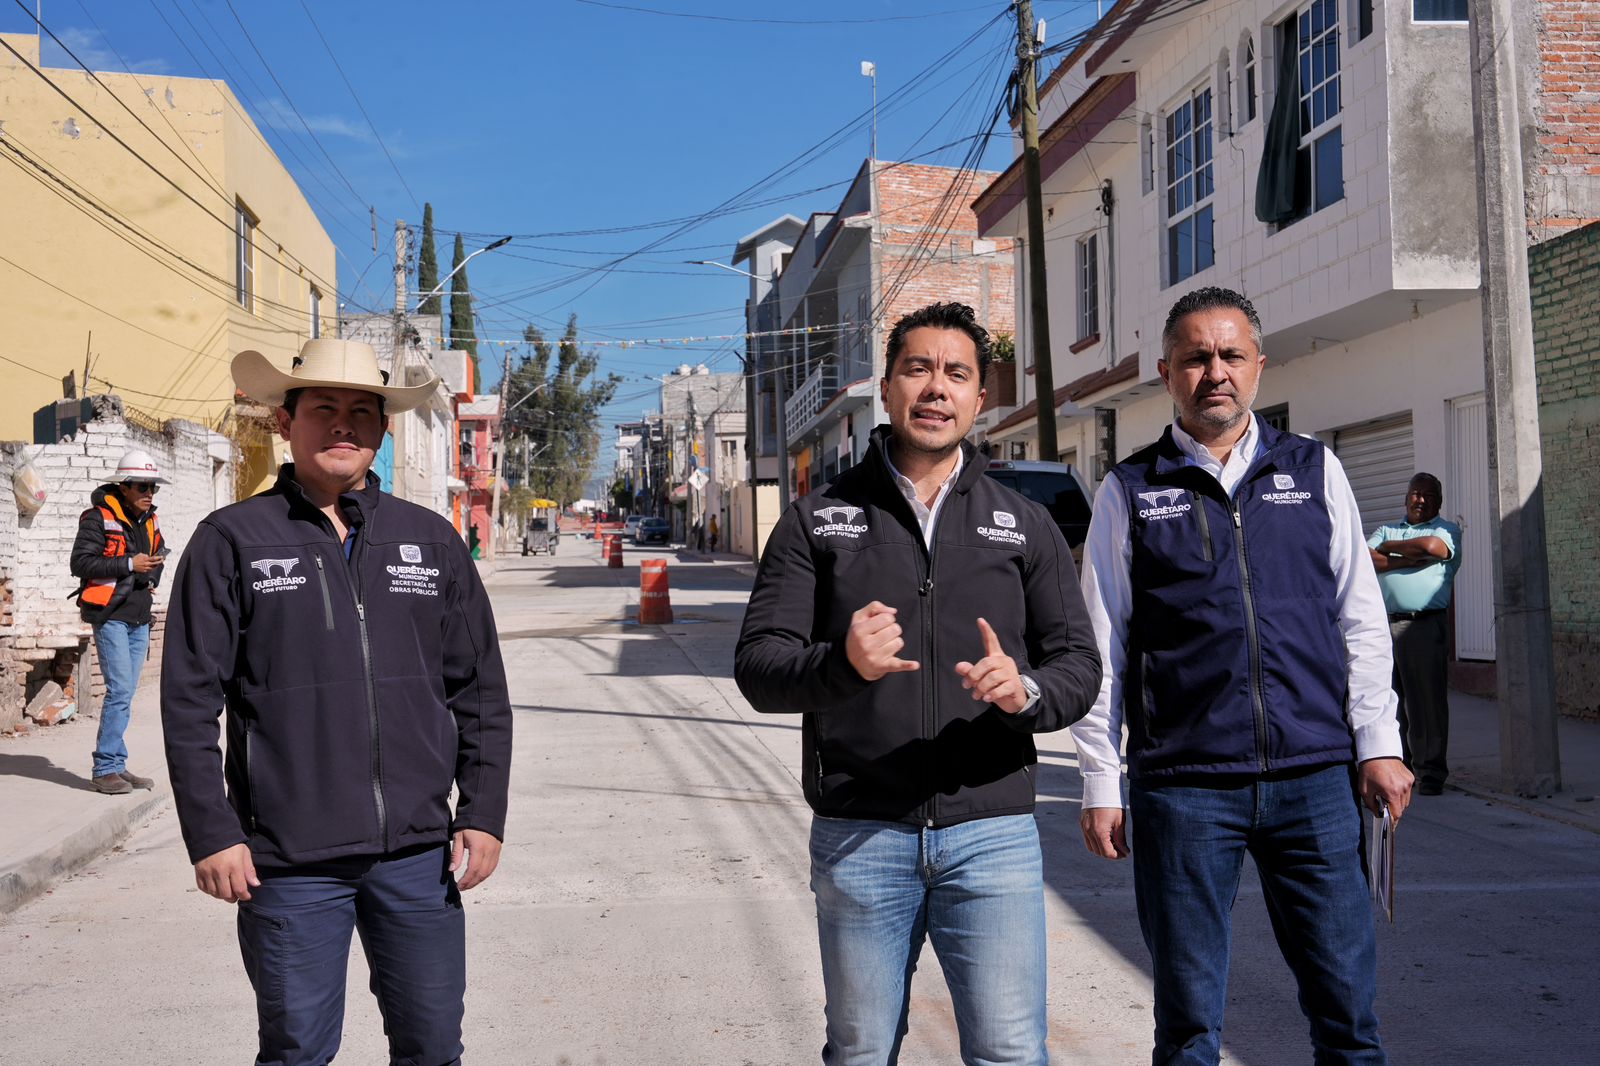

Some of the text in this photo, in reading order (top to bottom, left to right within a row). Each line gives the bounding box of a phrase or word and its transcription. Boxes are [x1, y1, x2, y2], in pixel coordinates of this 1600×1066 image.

[1161, 512, 1183, 520] FUTURO
[836, 530, 859, 539] FUTURO
[988, 535, 1022, 545] MUNICIPIO
[398, 573, 429, 582] MUNICIPIO
[391, 579, 428, 588] SECRETARÍA
[389, 586, 439, 597] OBRAS PÚBLICAS
